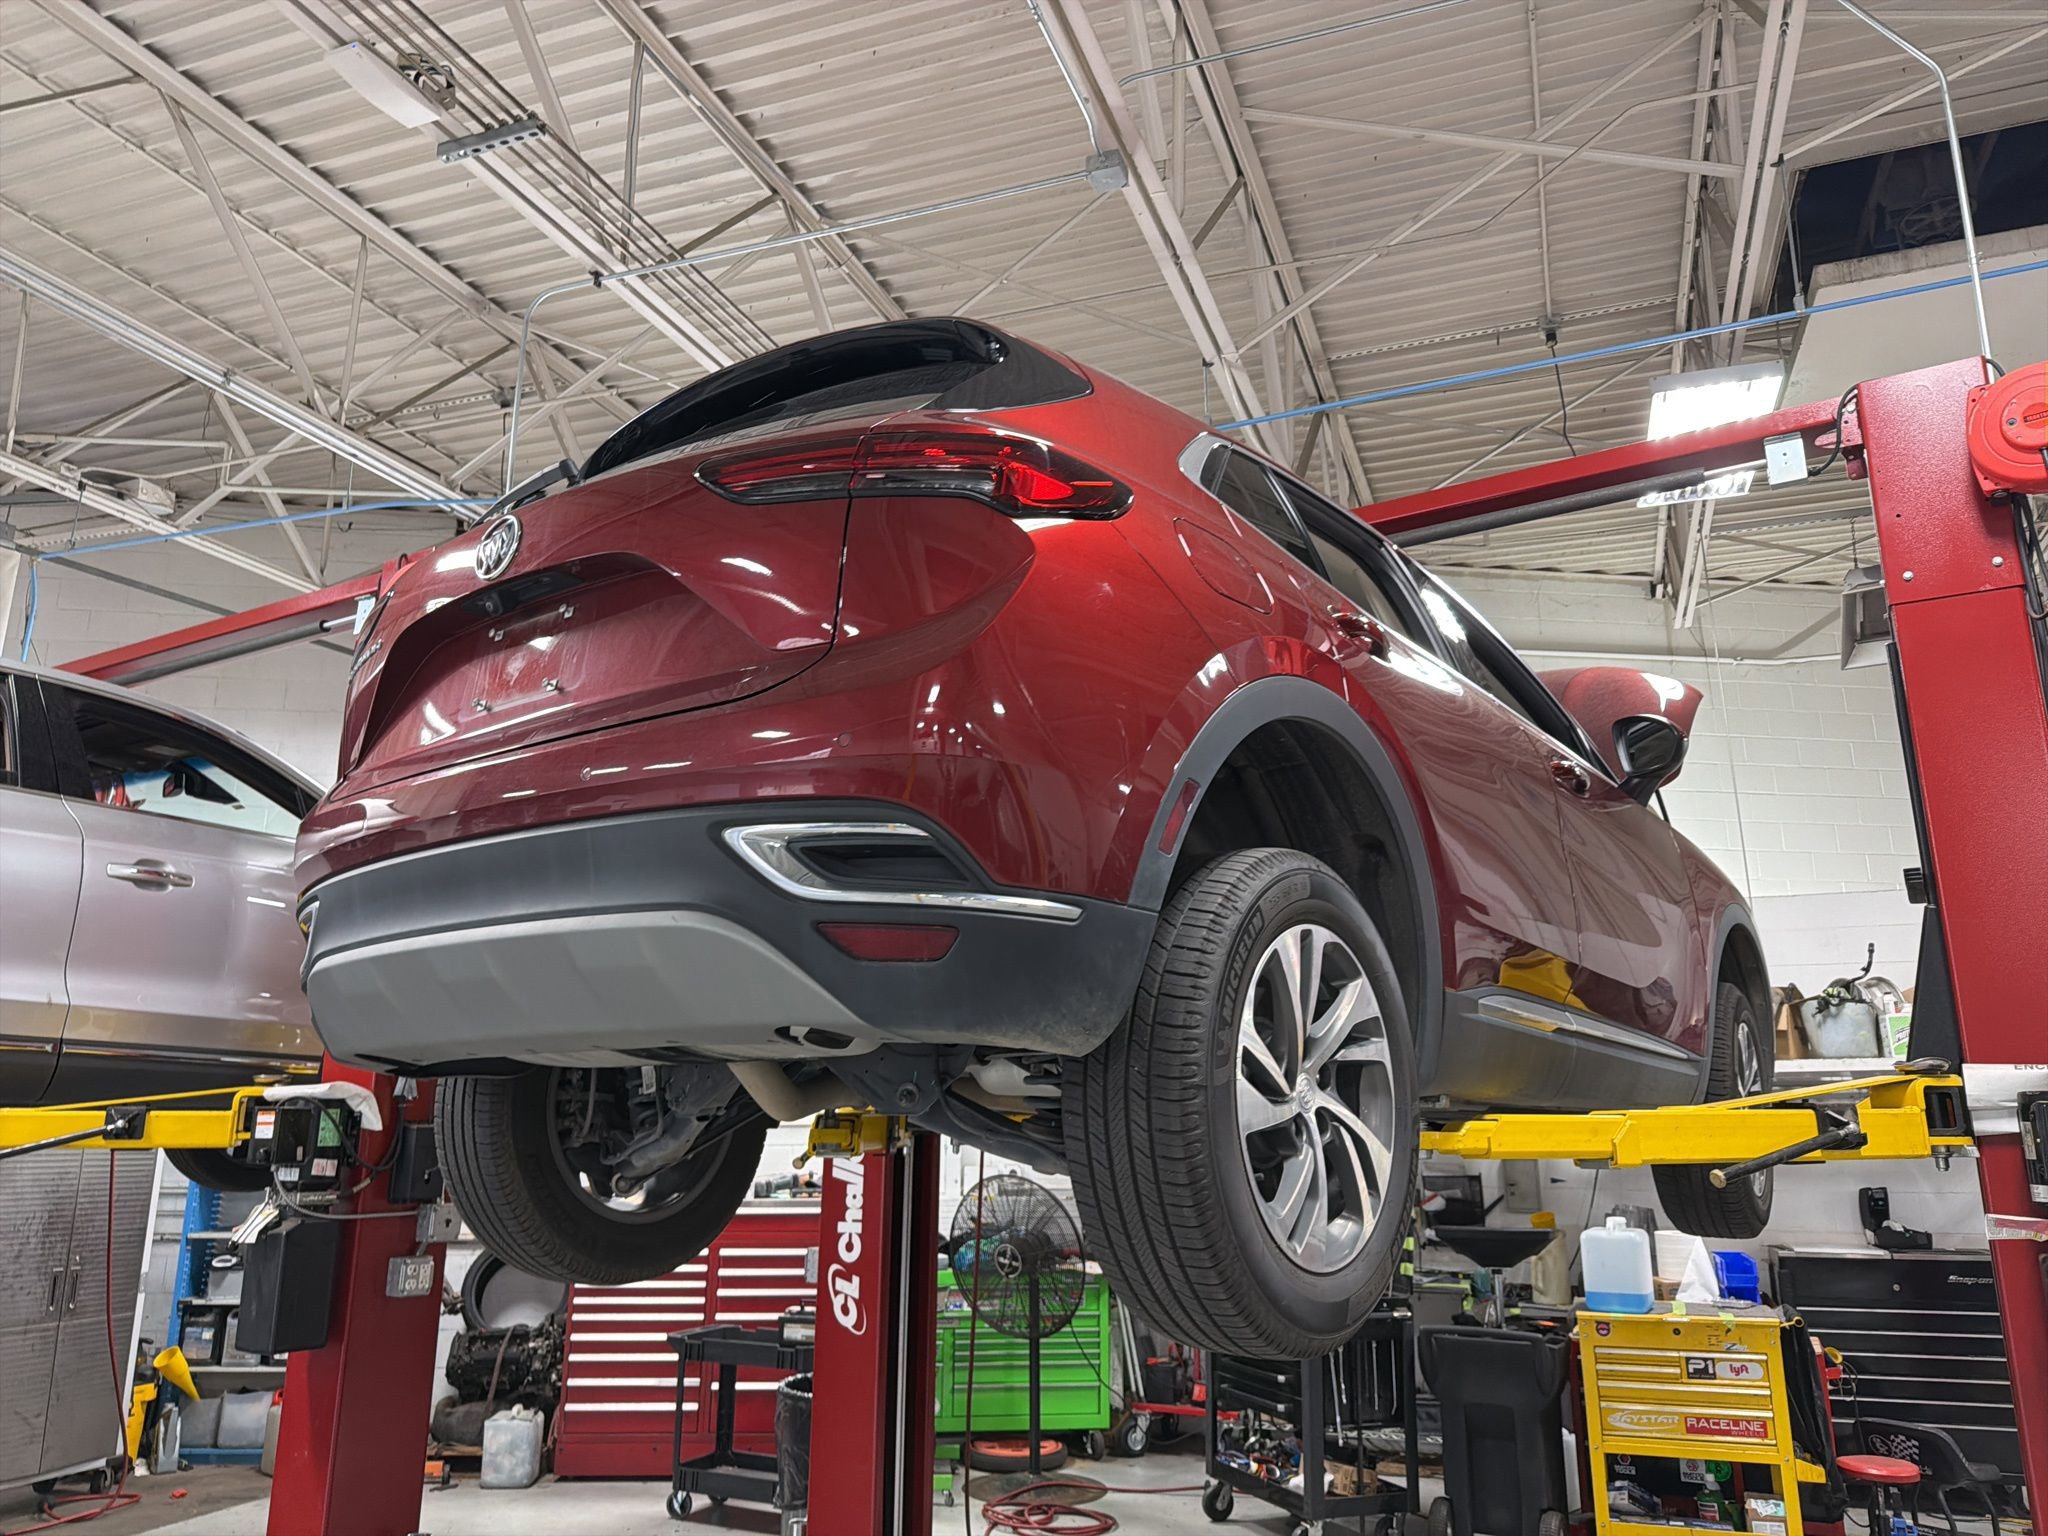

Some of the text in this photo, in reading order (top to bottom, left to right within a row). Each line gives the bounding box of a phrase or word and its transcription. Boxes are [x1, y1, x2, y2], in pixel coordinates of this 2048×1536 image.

[1222, 911, 1264, 1024] MICHELIN
[831, 1271, 861, 1330] CL
[1688, 1359, 1714, 1374] P1
[1729, 1363, 1749, 1376] lyft
[1686, 1417, 1765, 1432] RACELINE
